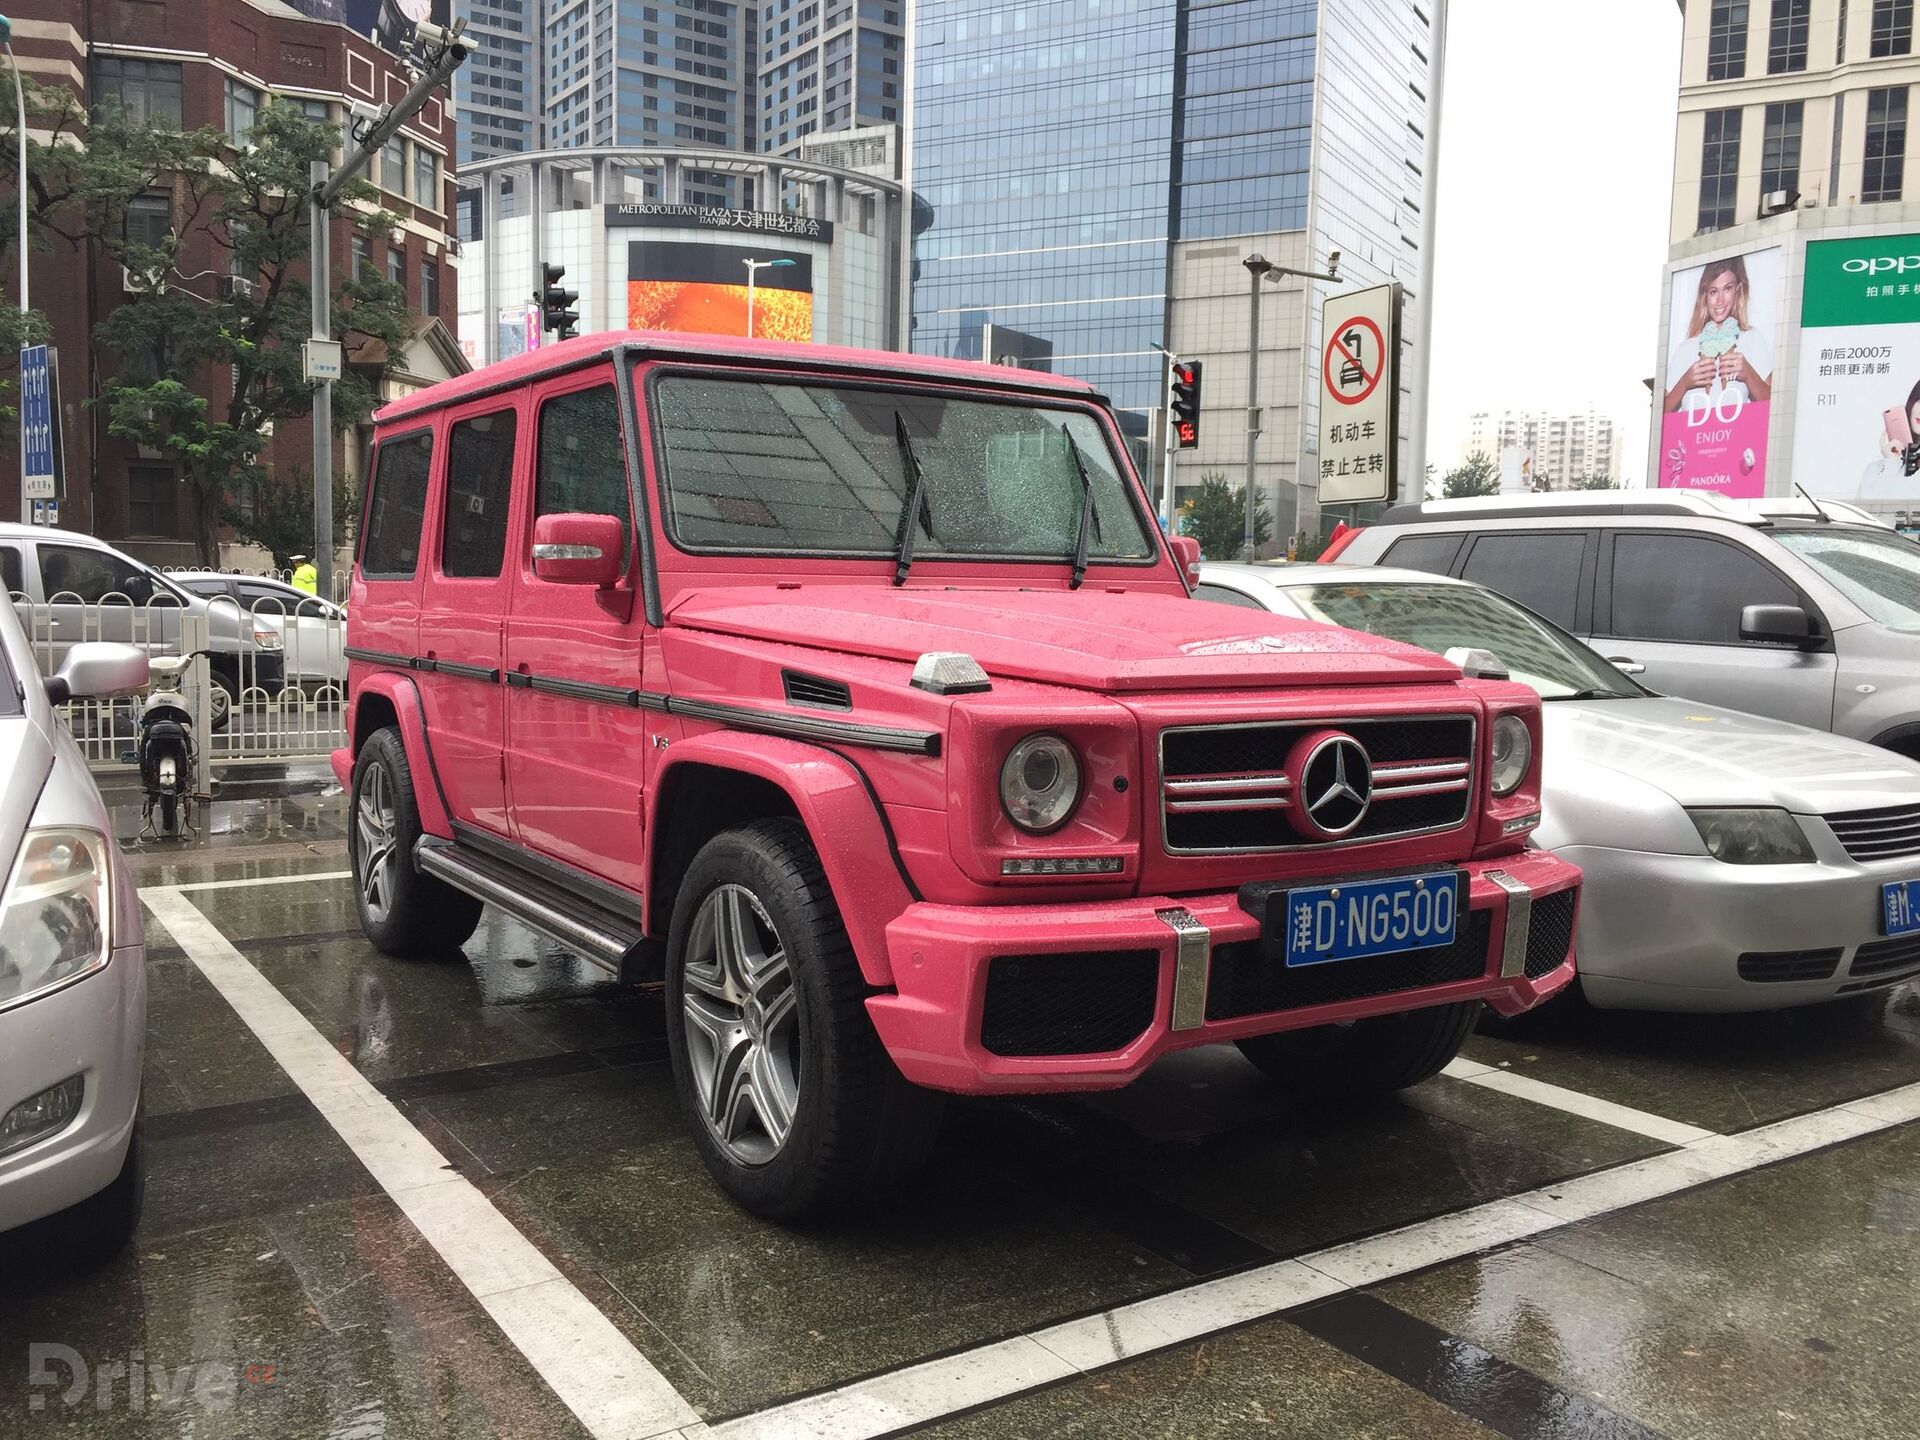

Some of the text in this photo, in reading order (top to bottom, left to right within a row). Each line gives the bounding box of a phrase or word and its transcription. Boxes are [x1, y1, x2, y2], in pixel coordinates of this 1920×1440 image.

[618, 204, 731, 218] METROPOLITAN PLAZA
[698, 215, 731, 227] TIANJIN
[731, 208, 821, 237] 天津世纪都会
[1820, 346, 1893, 361] 前后2000万
[1819, 362, 1891, 377] 拍照更清晰
[1687, 387, 1744, 427] DO
[1329, 419, 1376, 444] 机动车
[1696, 429, 1733, 444] ENJOY
[1321, 453, 1384, 479] 禁止左转
